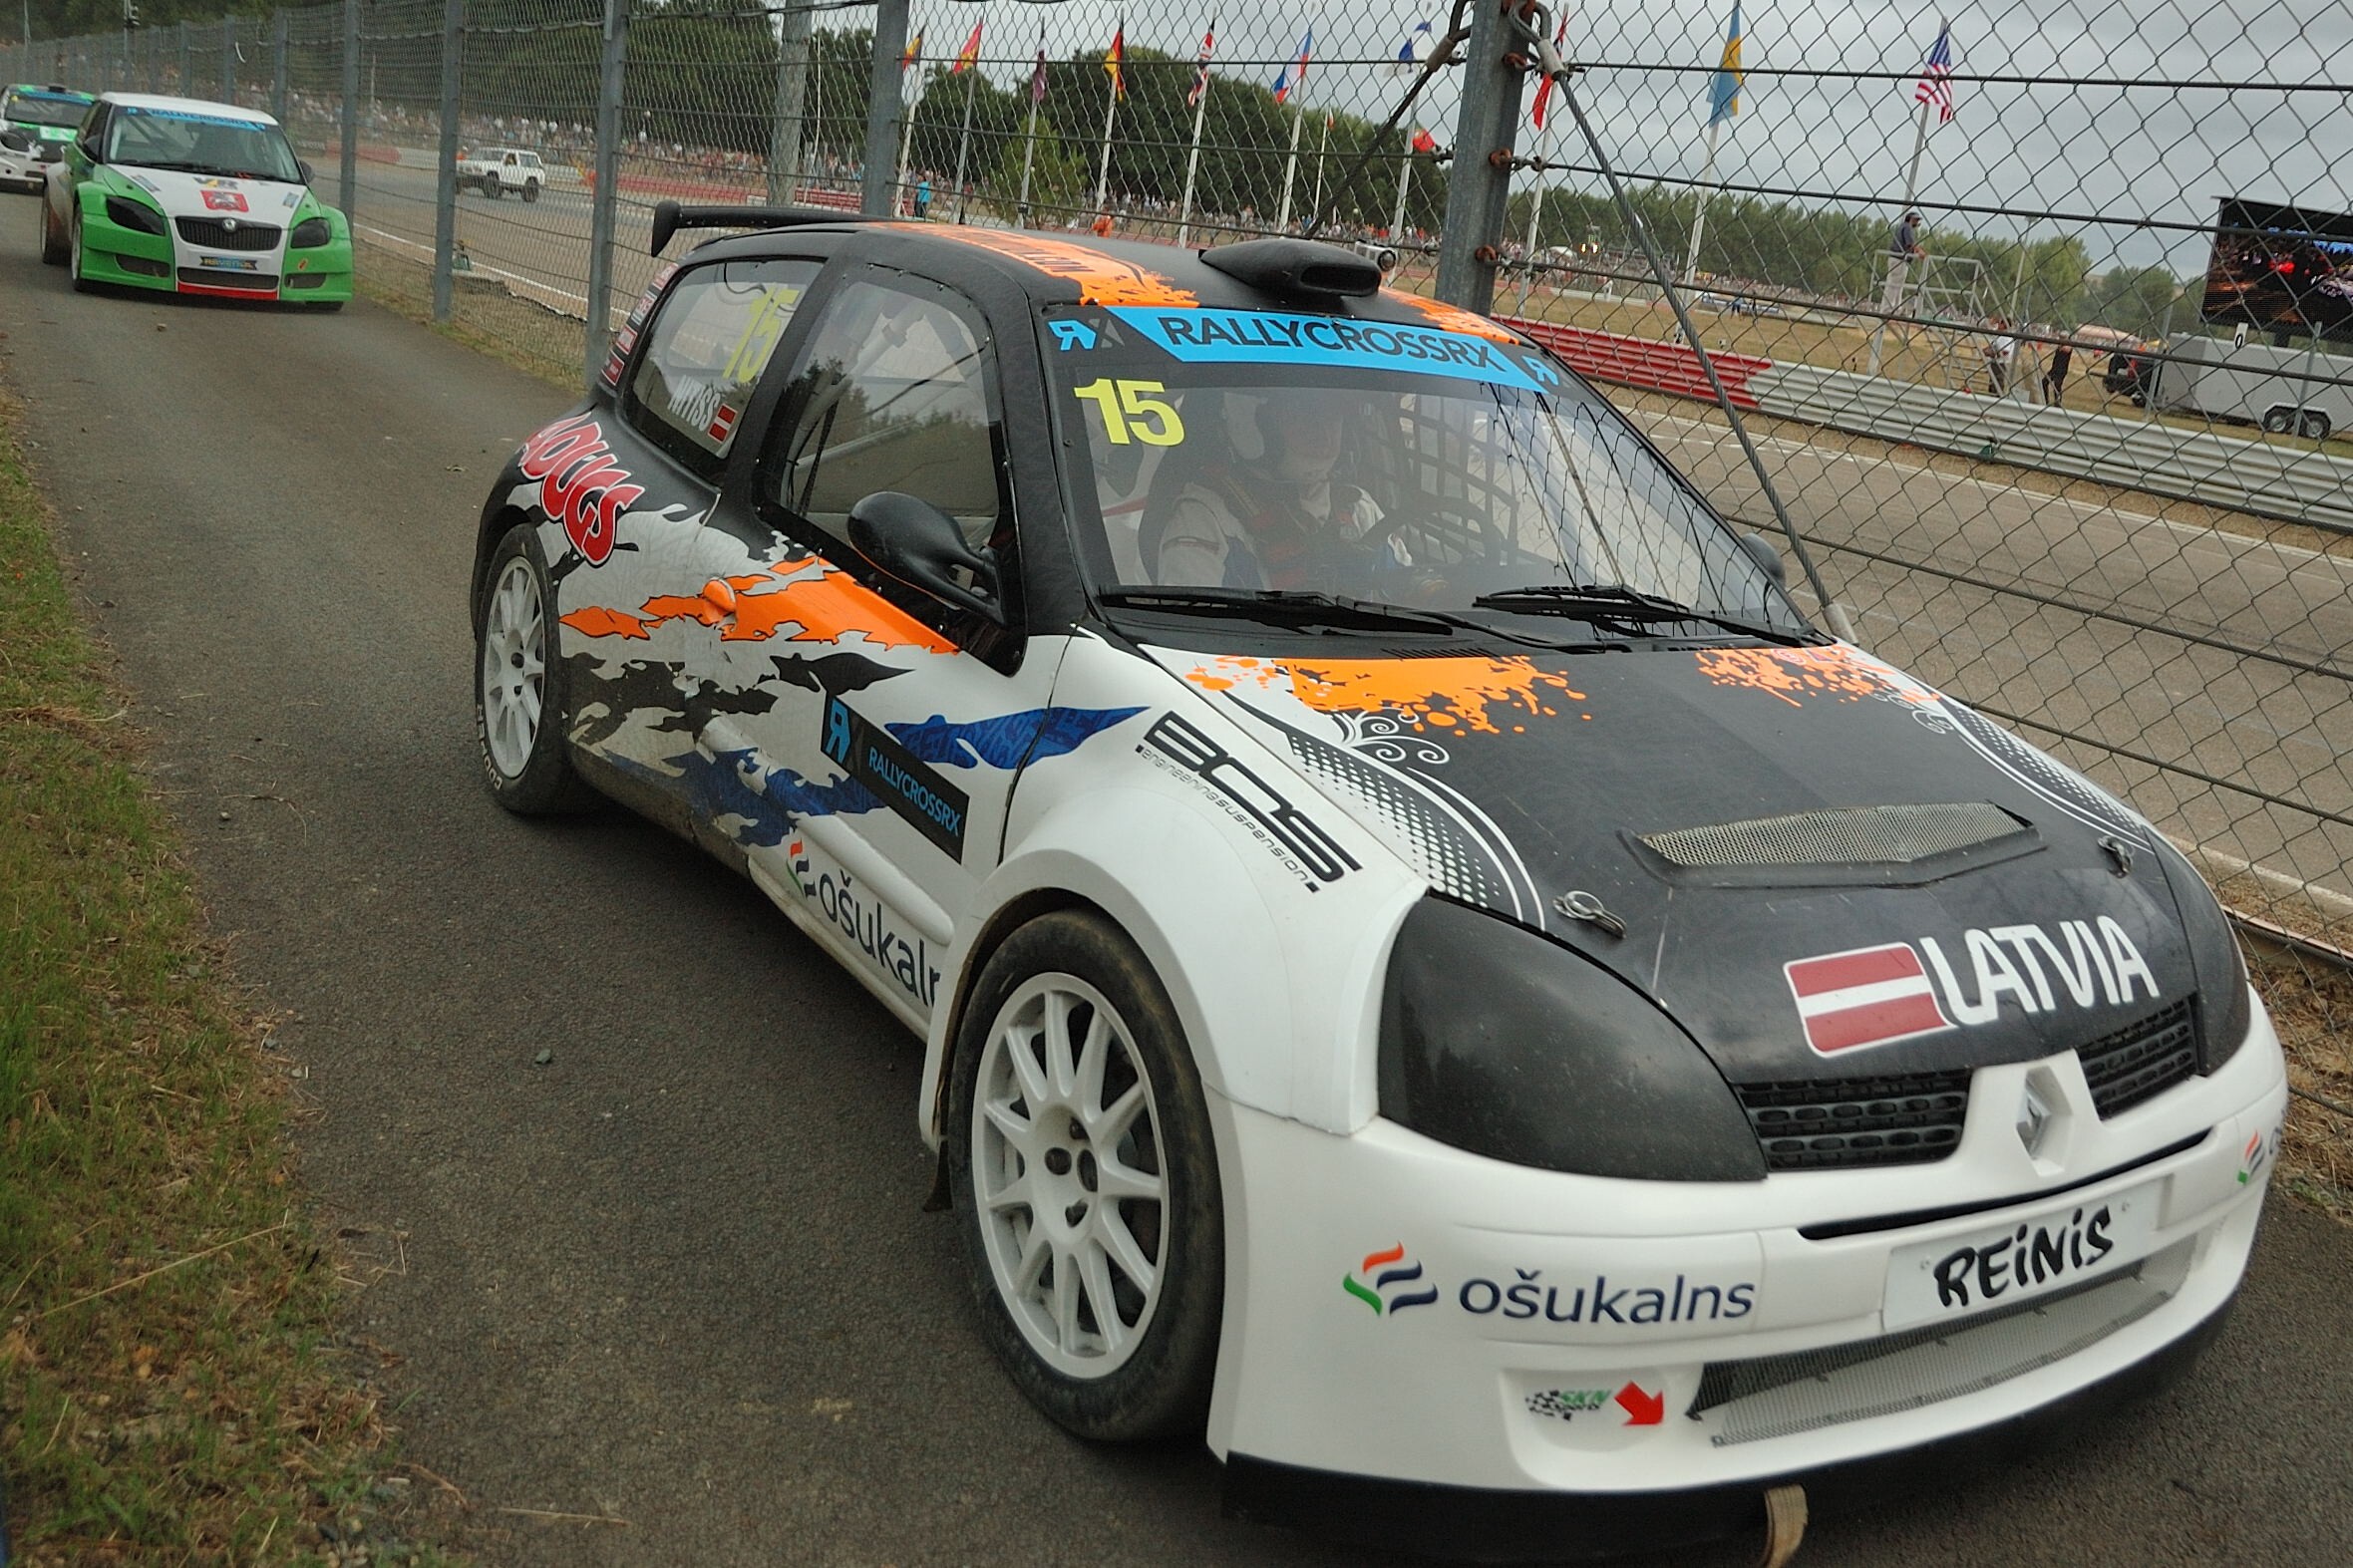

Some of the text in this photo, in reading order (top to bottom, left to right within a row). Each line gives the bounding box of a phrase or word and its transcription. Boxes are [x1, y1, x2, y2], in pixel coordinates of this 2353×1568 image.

[722, 282, 800, 384] 15
[1157, 316, 1507, 373] RALLYCROSSRX
[1074, 378, 1185, 447] 15
[868, 746, 961, 836] RALLYCROSSRX
[1918, 915, 2161, 1025] LATVIA
[1458, 1267, 1756, 1324] ošukalns
